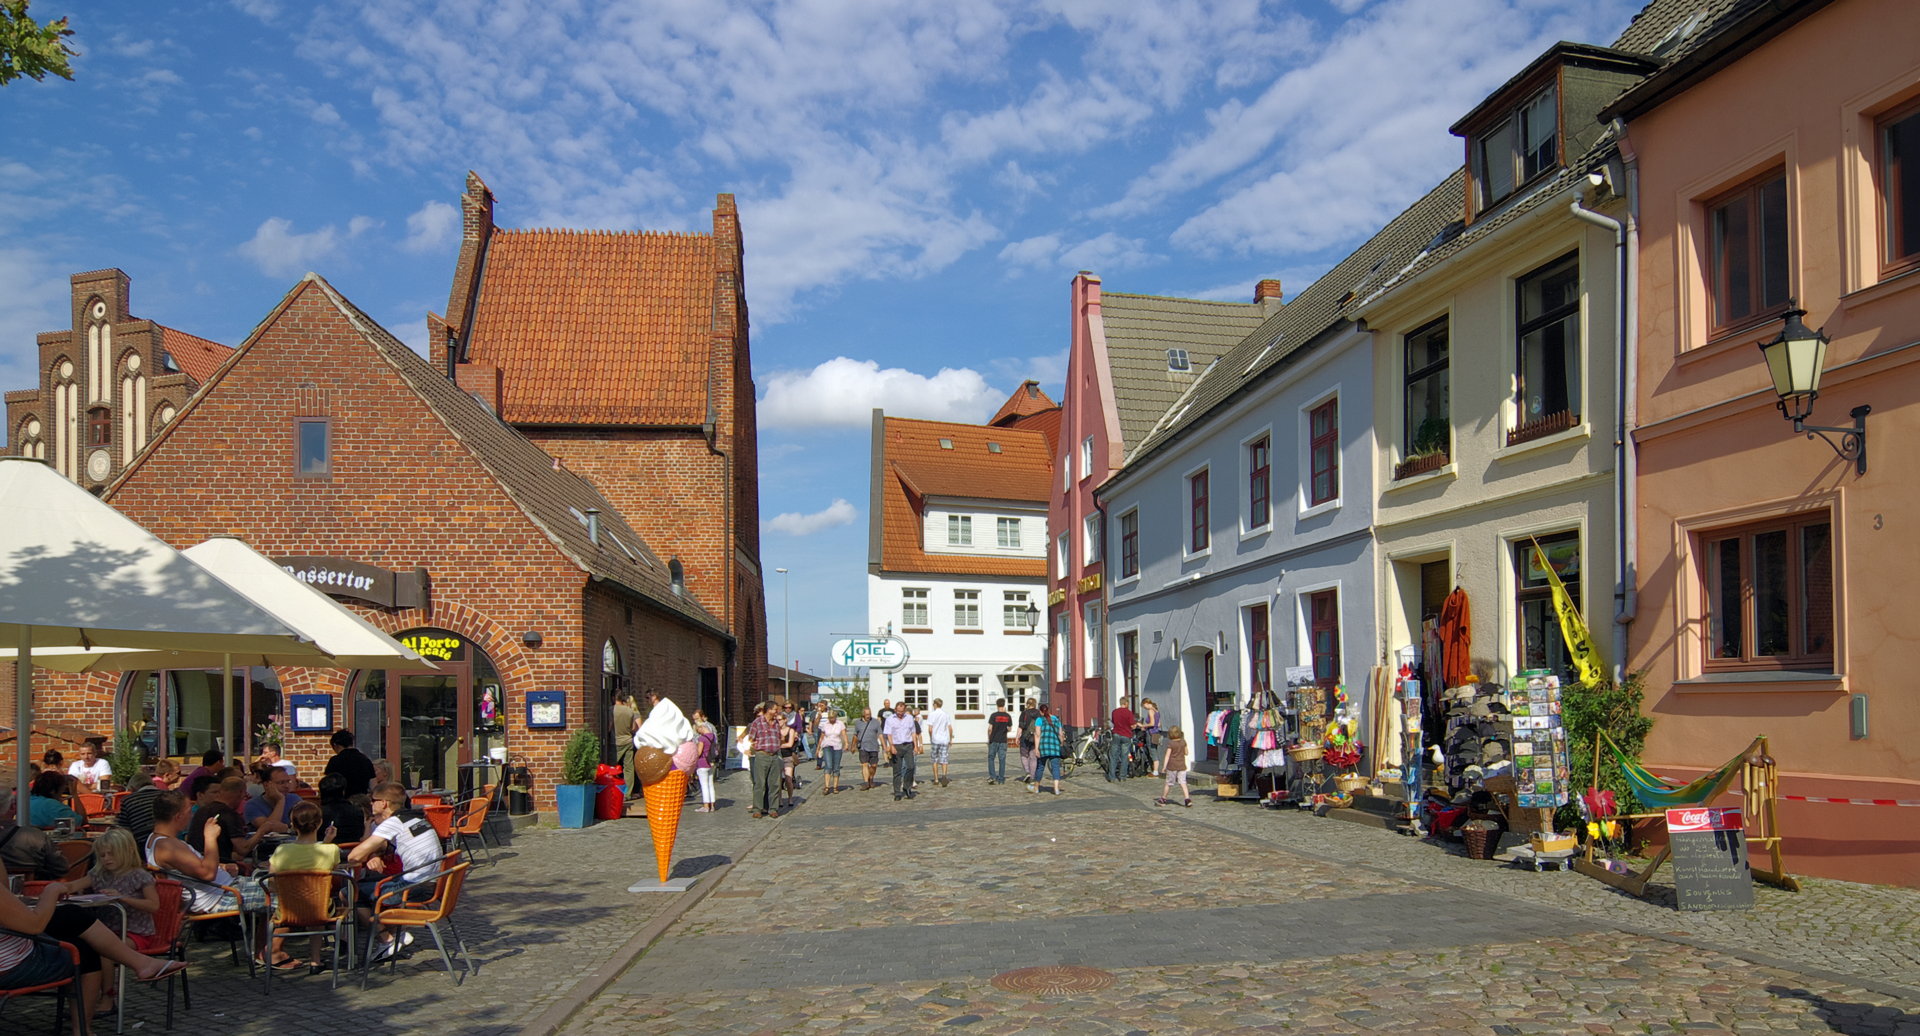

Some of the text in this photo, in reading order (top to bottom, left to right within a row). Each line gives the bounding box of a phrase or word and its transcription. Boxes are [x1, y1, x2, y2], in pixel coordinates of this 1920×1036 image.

[1872, 512, 1884, 531] 3
[401, 636, 460, 649] Al Porto
[411, 647, 453, 660] scafé
[842, 640, 895, 665] HOTEL
